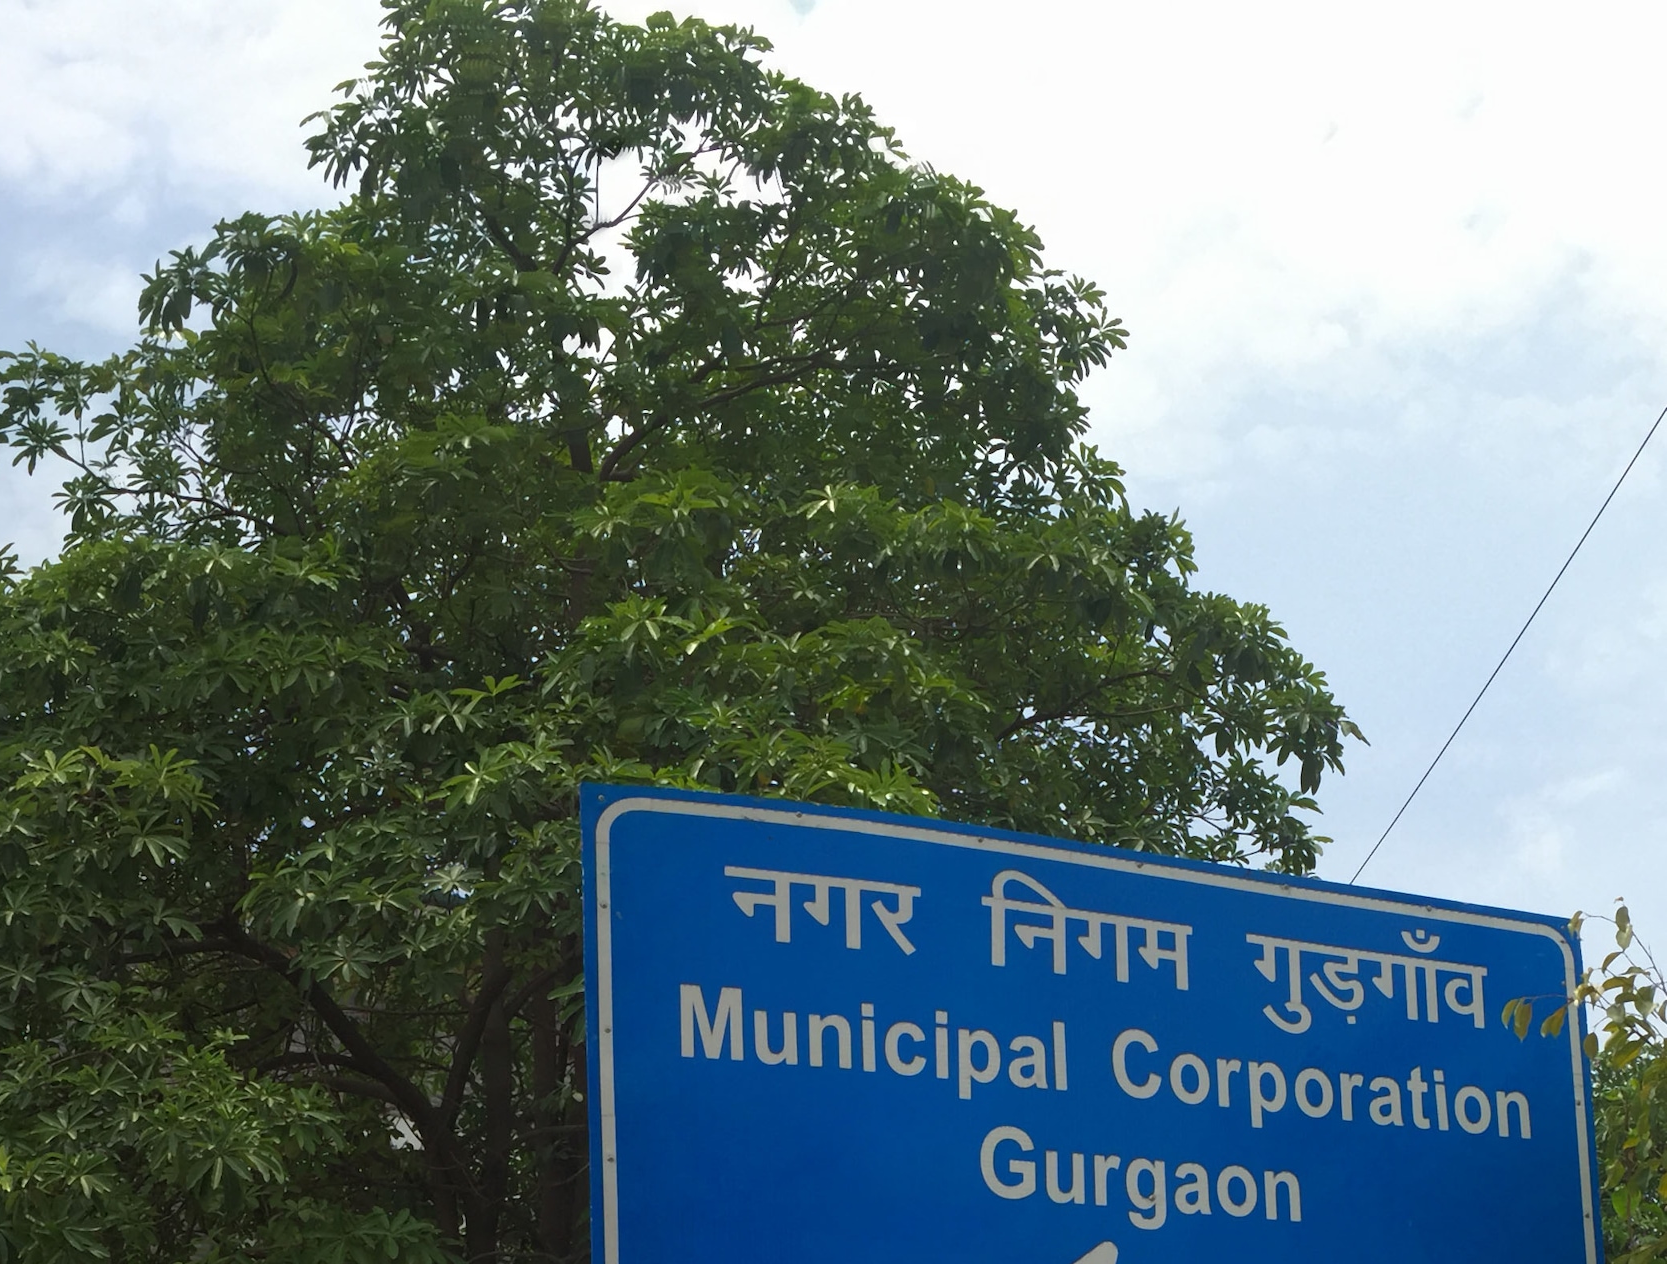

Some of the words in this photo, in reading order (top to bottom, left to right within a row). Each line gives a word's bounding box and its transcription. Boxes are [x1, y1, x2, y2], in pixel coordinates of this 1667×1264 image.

[724, 865, 922, 956] नगर
[981, 869, 1193, 991] निगम
[1246, 928, 1488, 1034] गुड़गाँव
[679, 983, 1068, 1100] Municipal
[1111, 1027, 1532, 1140] Corporation
[979, 1125, 1302, 1231] Gurgaon
